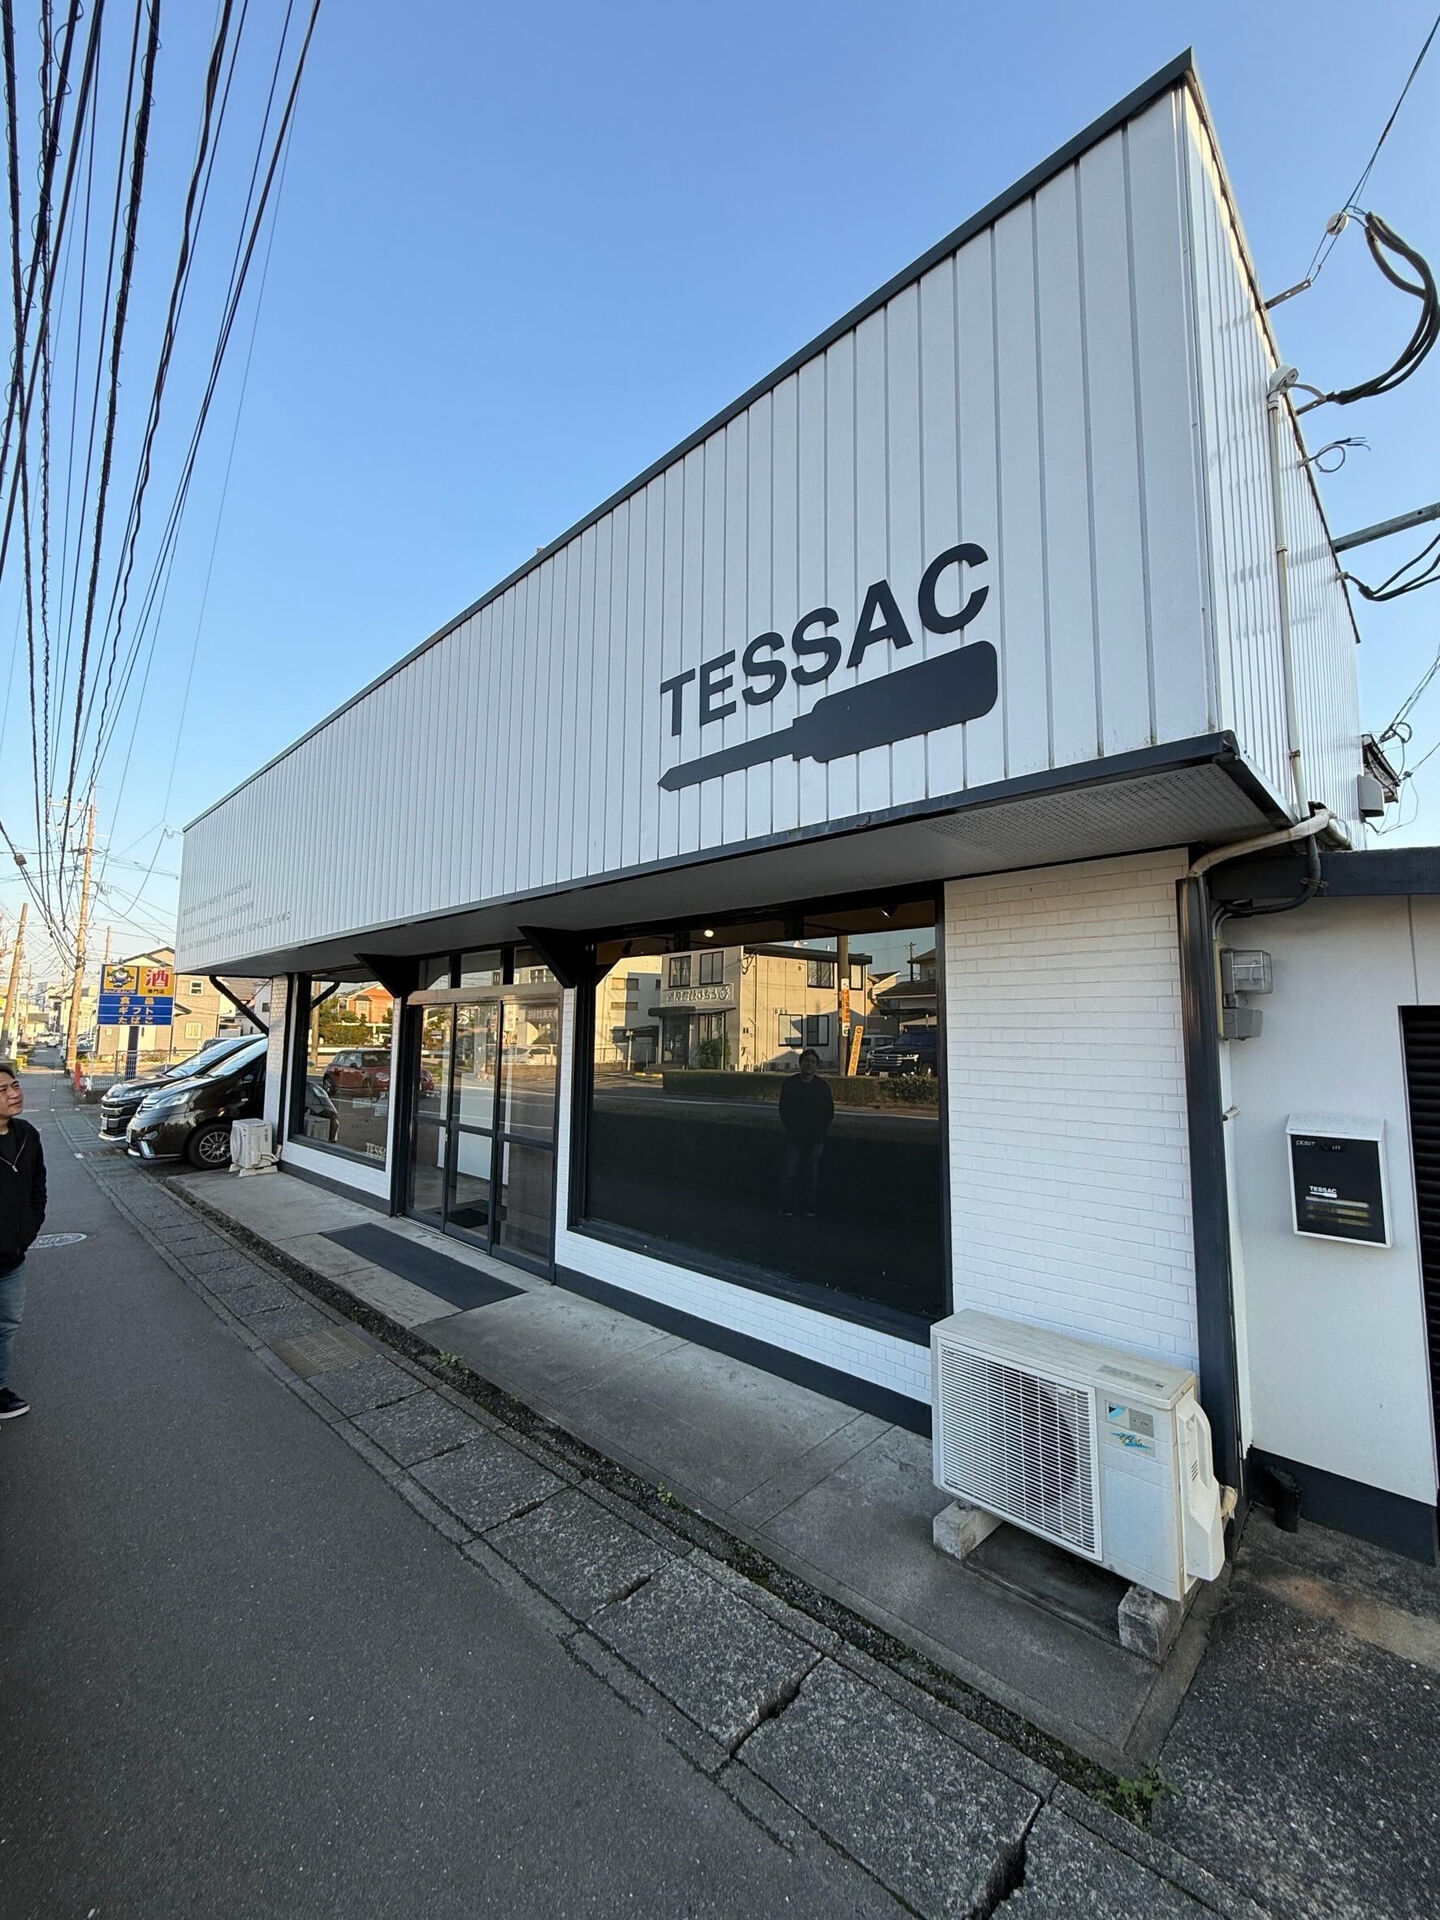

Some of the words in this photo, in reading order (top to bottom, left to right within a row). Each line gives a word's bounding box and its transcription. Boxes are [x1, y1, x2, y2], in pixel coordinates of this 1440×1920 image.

[661, 543, 989, 737] TESSAC
[145, 969, 169, 987] 酒
[119, 1006, 154, 1015] ギフト
[118, 1016, 154, 1025] たばこ
[366, 1142, 386, 1161] TESS
[1309, 1185, 1337, 1194] TESSAC
